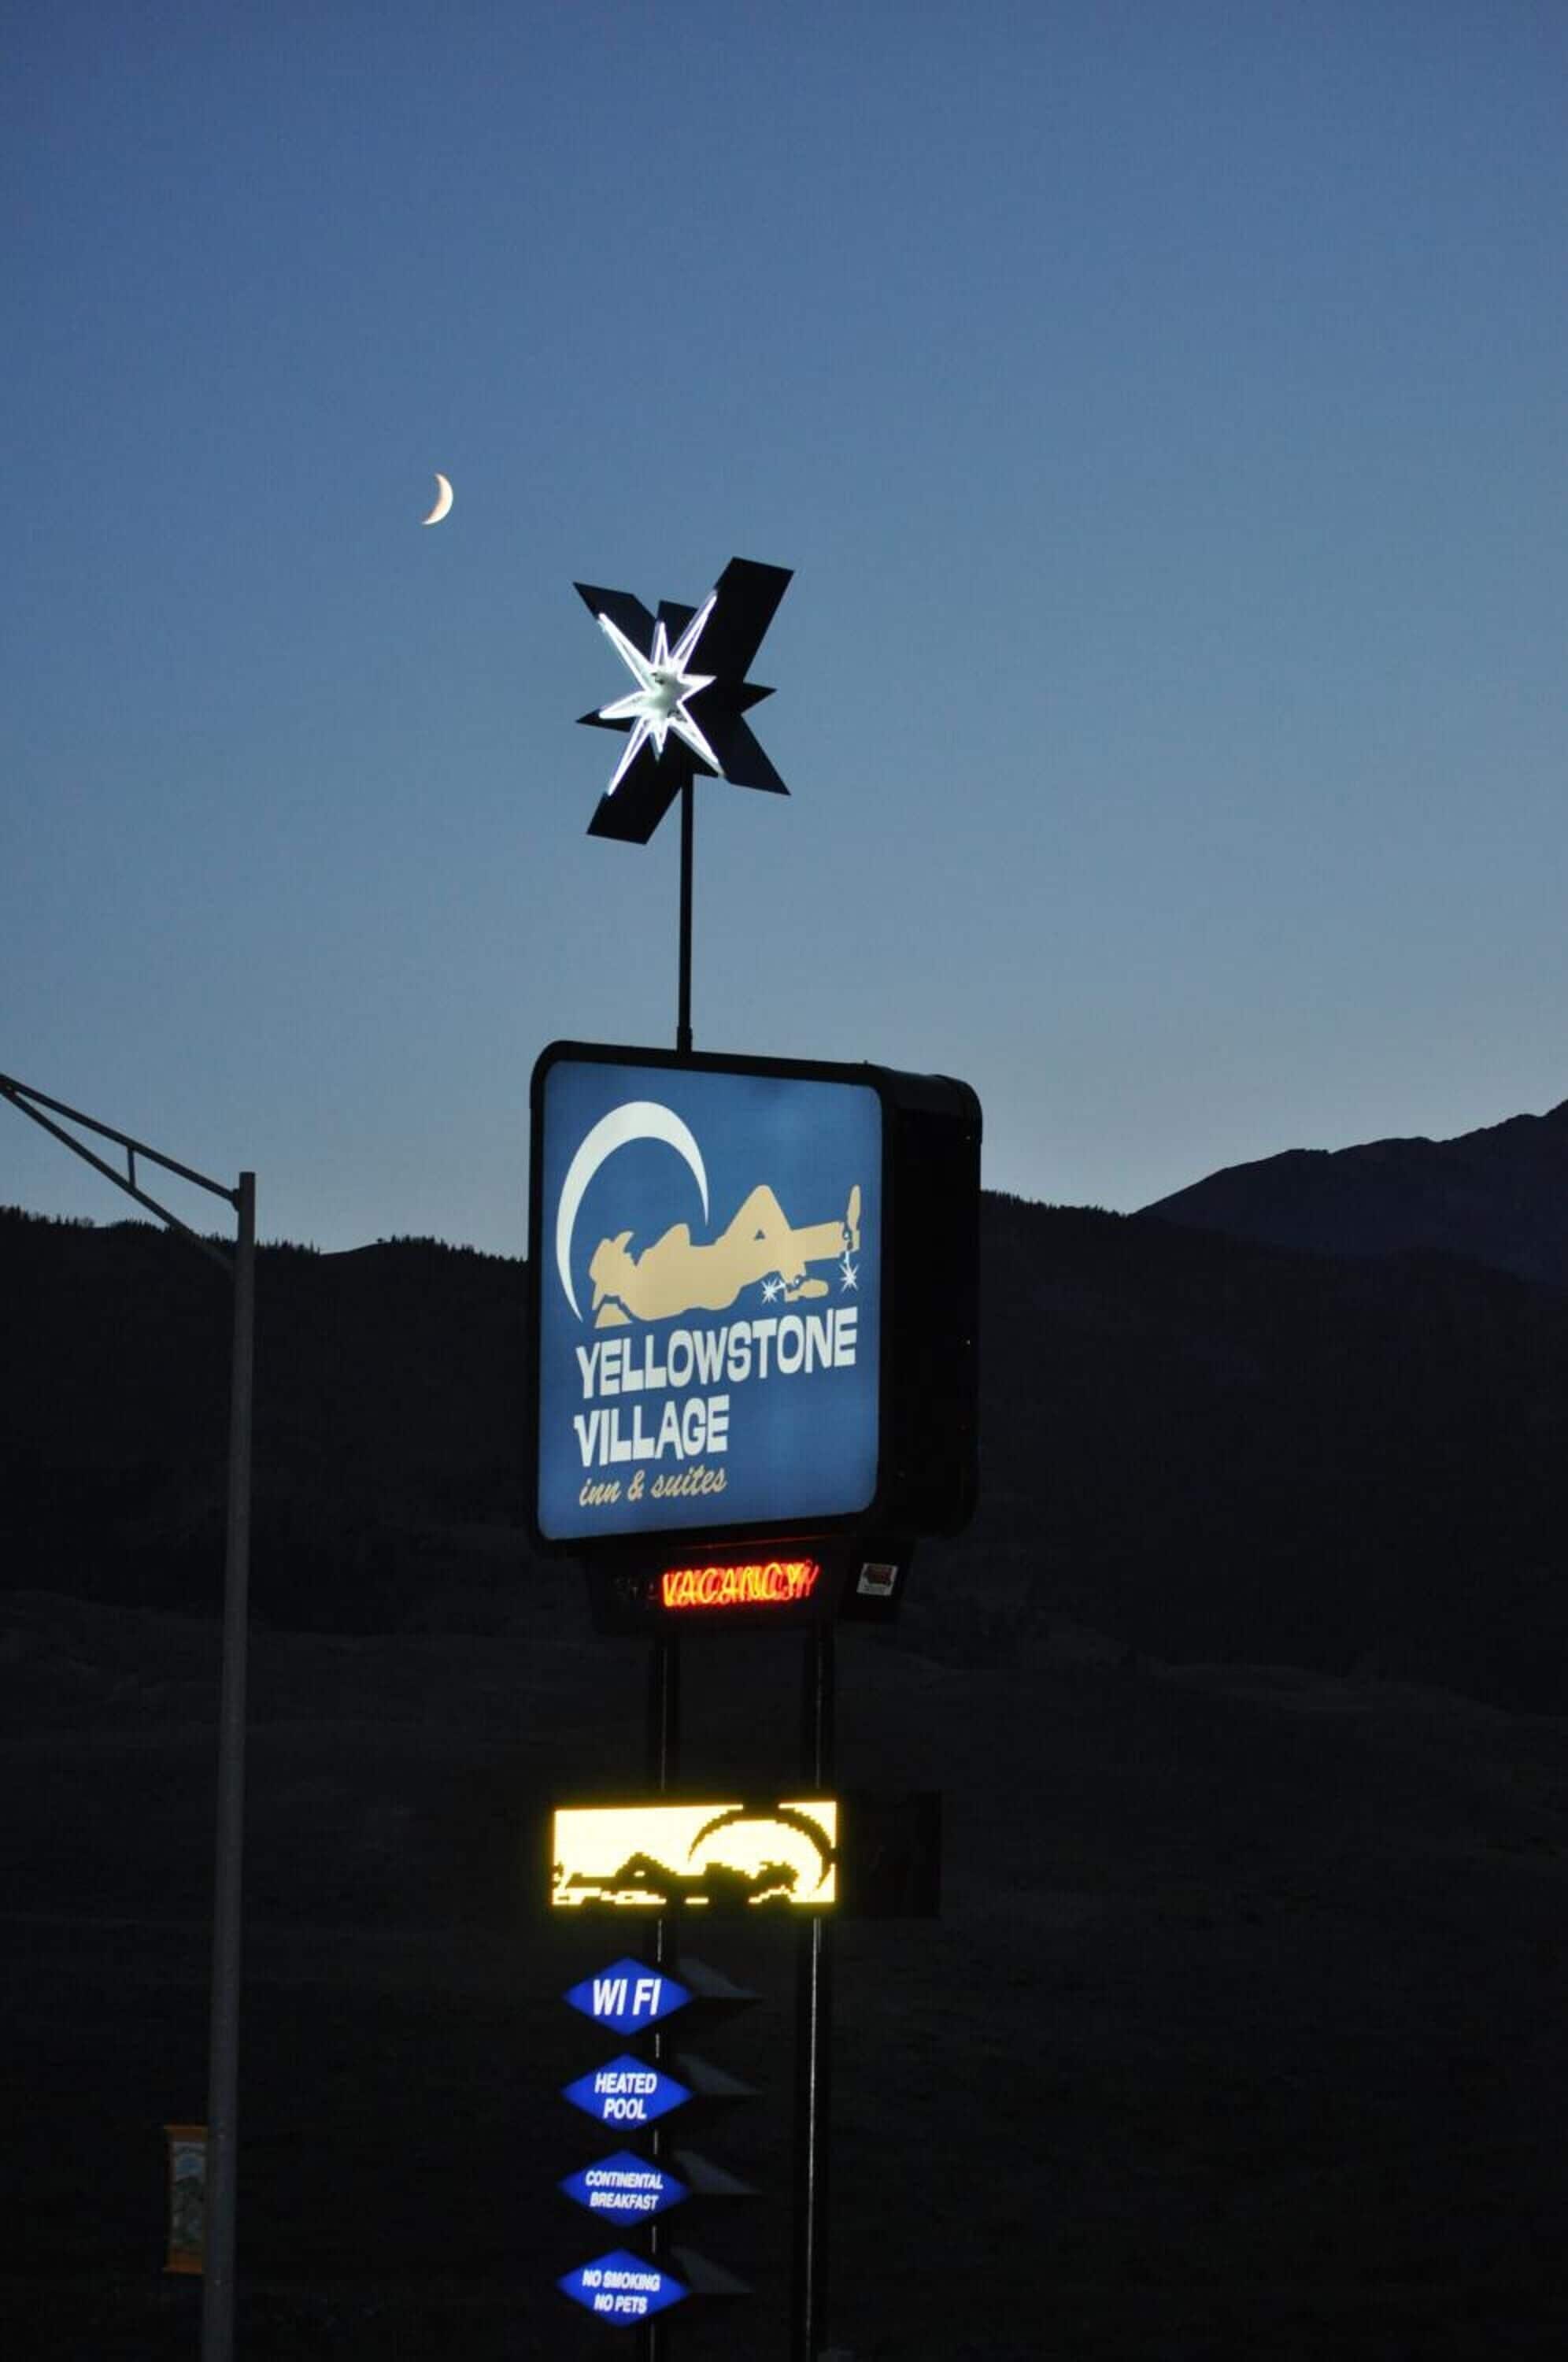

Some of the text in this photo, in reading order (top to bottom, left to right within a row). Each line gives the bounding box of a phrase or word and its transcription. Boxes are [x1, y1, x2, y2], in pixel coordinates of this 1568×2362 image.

[575, 1306, 858, 1399] YELLOWSTONE
[574, 1394, 730, 1468] VILLAGE
[579, 1464, 727, 1506] inn & suites
[662, 1561, 813, 1608] VACANCY
[593, 1978, 662, 2016] WI FI
[594, 2072, 657, 2094] HEATED
[602, 2097, 648, 2120] POOL
[585, 2170, 664, 2190] CONTINENTAL
[590, 2191, 659, 2210] BREAKFAST
[582, 2269, 661, 2292] NO SMOKING
[594, 2294, 648, 2315] NO PETS
